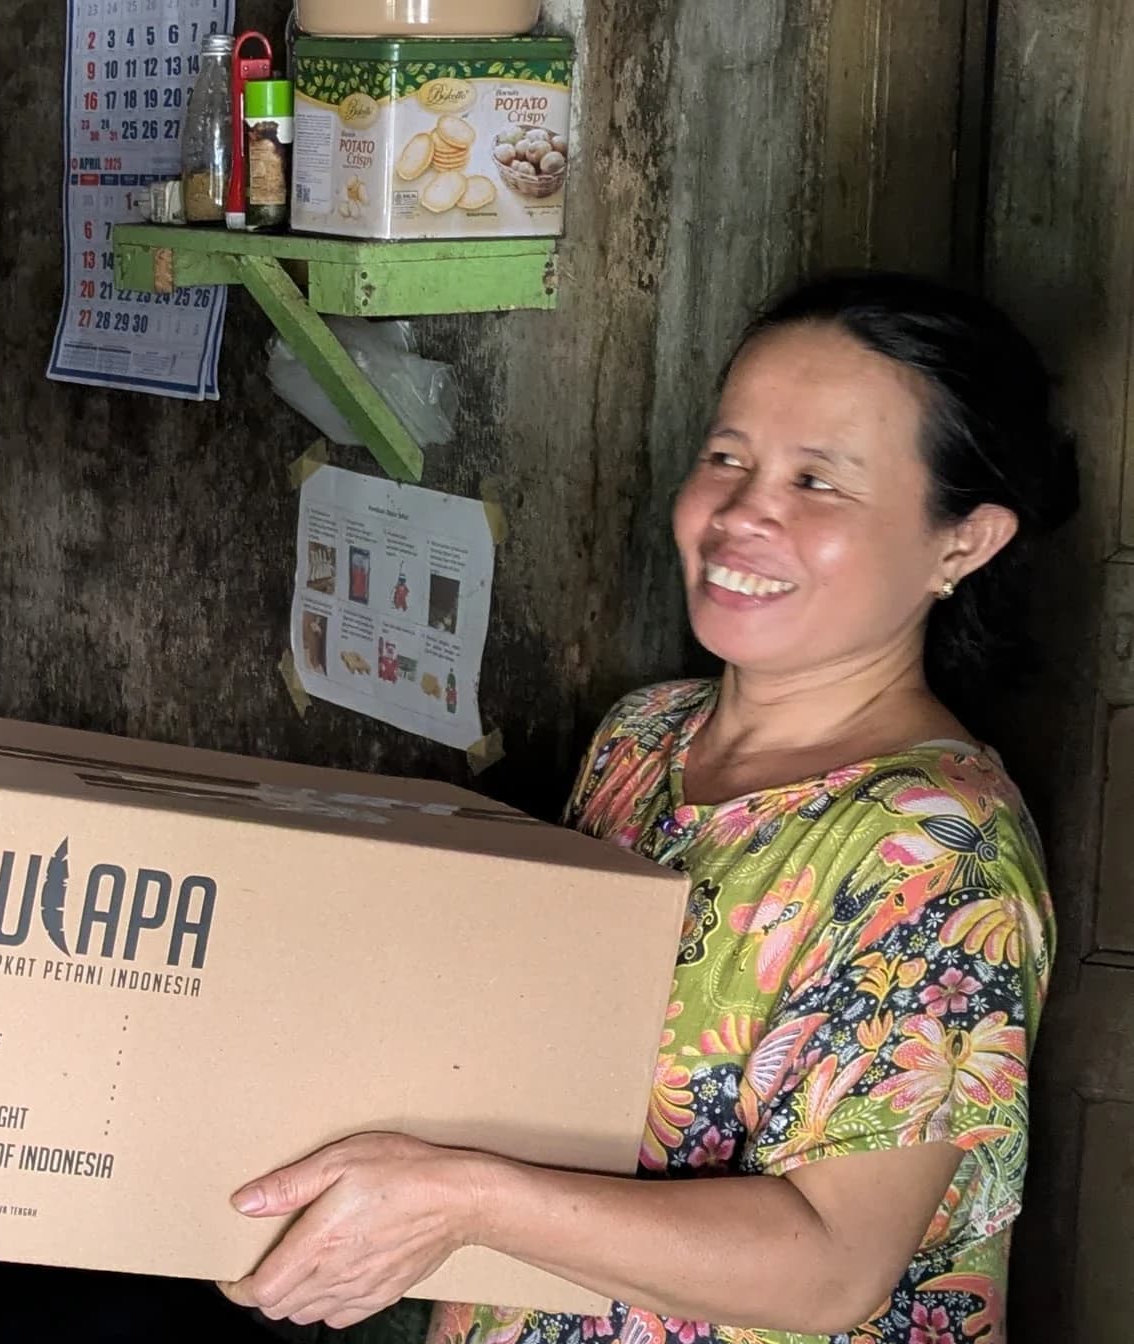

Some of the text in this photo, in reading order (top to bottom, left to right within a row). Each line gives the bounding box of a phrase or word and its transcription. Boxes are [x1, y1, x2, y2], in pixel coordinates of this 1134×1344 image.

[88, 31, 96, 49] 2
[107, 30, 116, 48] 3
[126, 28, 135, 47] 4
[146, 26, 155, 45] 5
[168, 25, 178, 44] 6
[191, 23, 199, 42] 7
[87, 55, 200, 80] 9 10 11 12 13 14
[84, 92, 98, 111] 16
[104, 91, 117, 110] 17
[123, 90, 137, 109] 18
[144, 89, 158, 108] 19
[163, 88, 182, 107] 20
[494, 96, 548, 111] POTATO
[507, 110, 548, 126] Crispy
[81, 120, 90, 130] 23
[121, 120, 138, 140] 25
[142, 120, 158, 140] 26
[164, 119, 180, 139] 27
[339, 138, 375, 154] POTATO
[79, 157, 122, 171] APRIL 2025
[346, 152, 373, 169] Crispy
[125, 192, 132, 210] 1
[84, 221, 111, 240] 6 7
[82, 251, 114, 270] 13 14
[80, 280, 95, 299] 20
[100, 281, 113, 300] 21
[117, 288, 132, 302] 22
[175, 288, 191, 307] 25
[194, 288, 210, 308] 26
[78, 310, 148, 333] 27 28 29 30
[43, 960, 103, 986] PETANI
[110, 969, 203, 998] INDONESIA
[18, 1145, 115, 1179] INDONESIA
[10, 1206, 39, 1218] TENGAH
